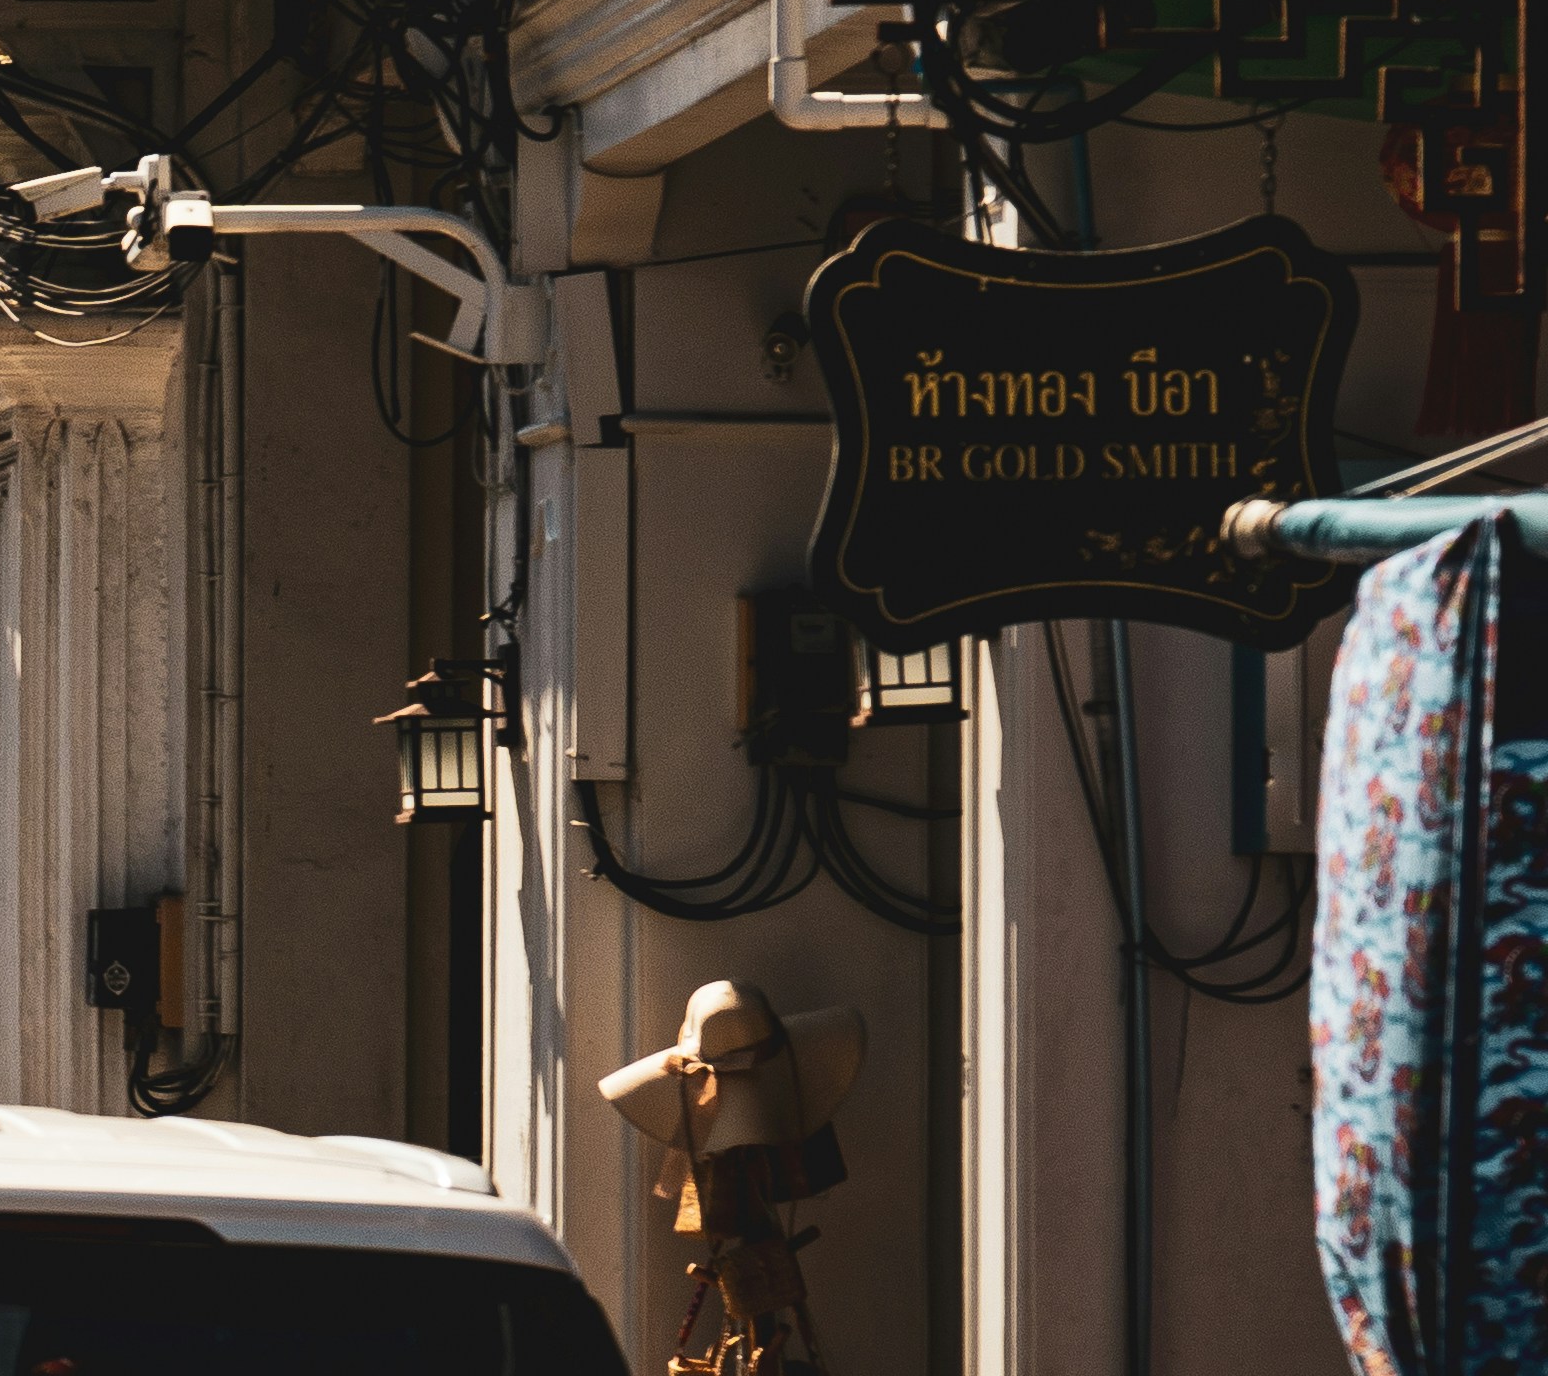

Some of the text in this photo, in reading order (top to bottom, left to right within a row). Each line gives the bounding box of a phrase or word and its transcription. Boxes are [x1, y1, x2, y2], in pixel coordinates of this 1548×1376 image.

[904, 349, 1098, 417] ห้างทอง
[889, 443, 1237, 481] BR GOLD SMITH
